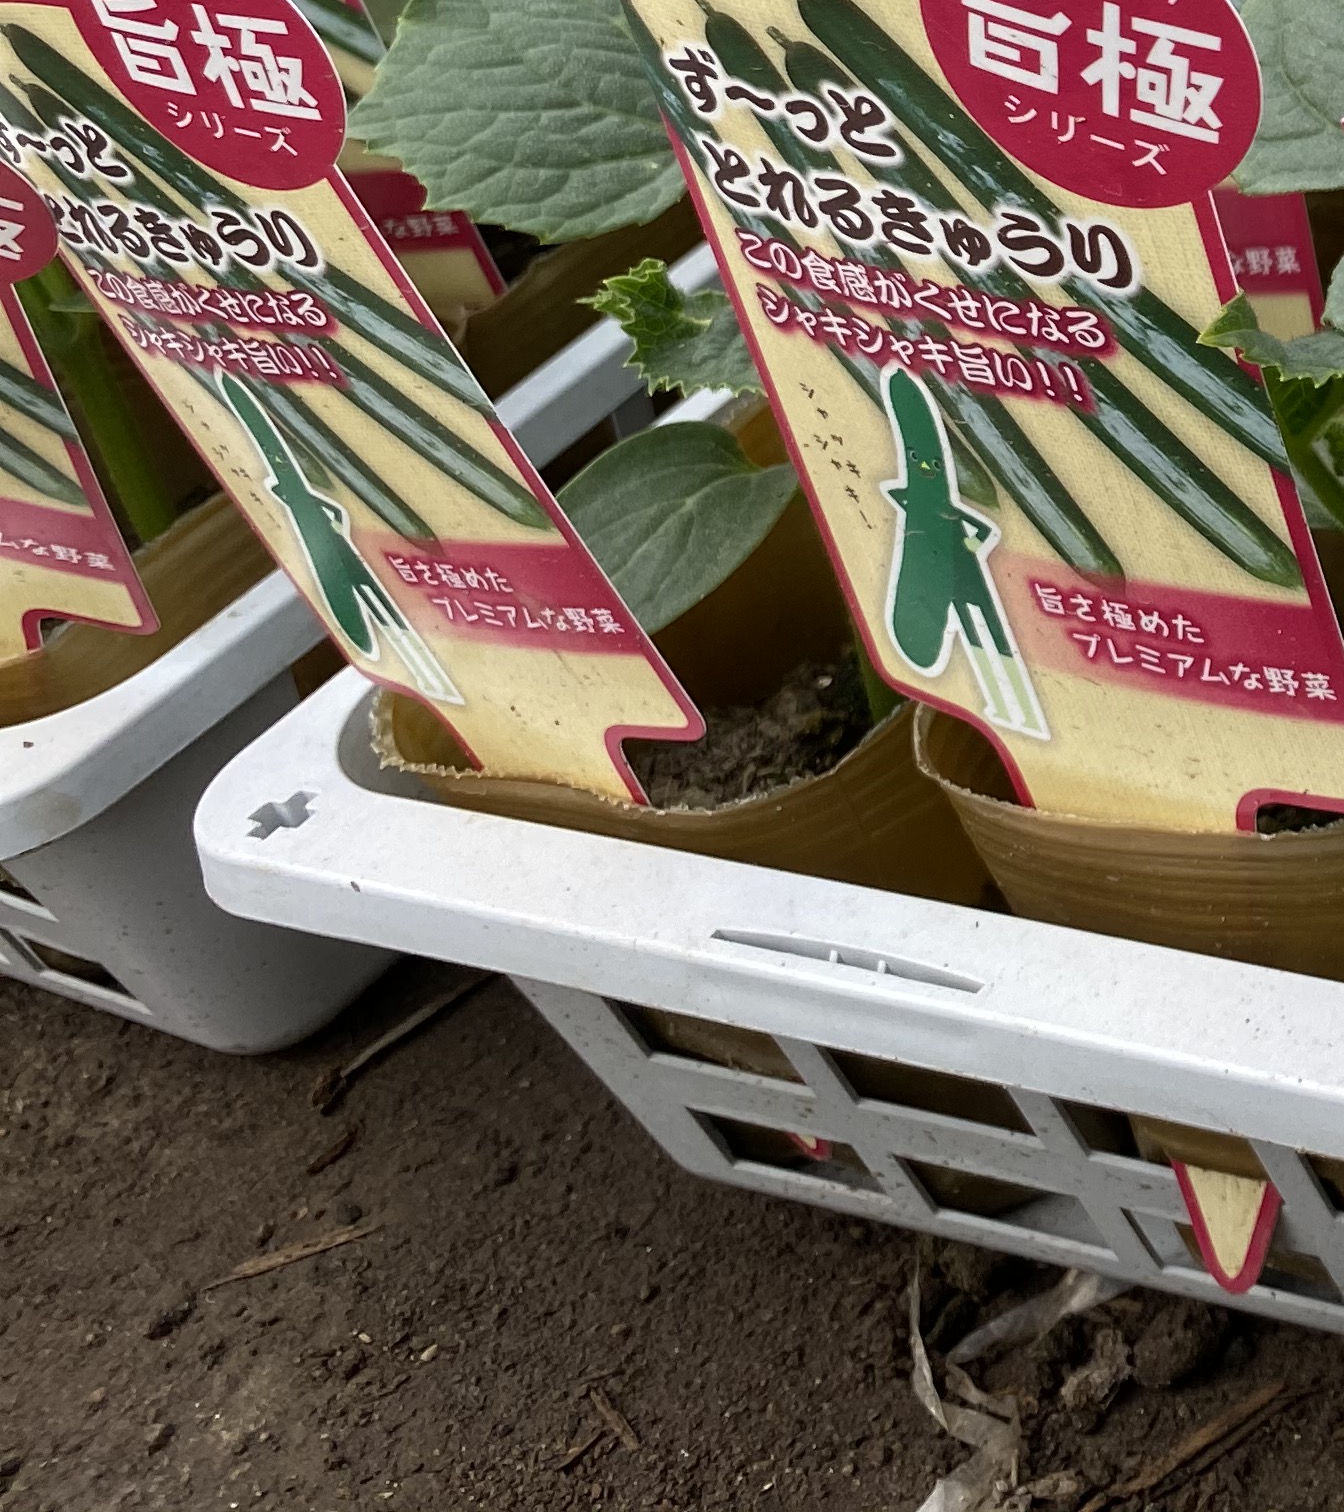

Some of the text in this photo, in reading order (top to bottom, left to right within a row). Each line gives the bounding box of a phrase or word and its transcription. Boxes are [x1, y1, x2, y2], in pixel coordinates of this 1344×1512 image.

[166, 102, 300, 156] シリーズ
[1003, 93, 1169, 176] シリーズ
[705, 140, 1132, 290] とれるきゅうり
[91, 268, 328, 330] この食感がくせになる
[739, 230, 1107, 349] この食感がくせになる
[390, 555, 513, 594] 旨さ極めた
[435, 599, 626, 636] プレミアムな野菜
[1033, 582, 1203, 644] 旨さ極めた
[1074, 631, 1339, 701] プレミアムな野菜
